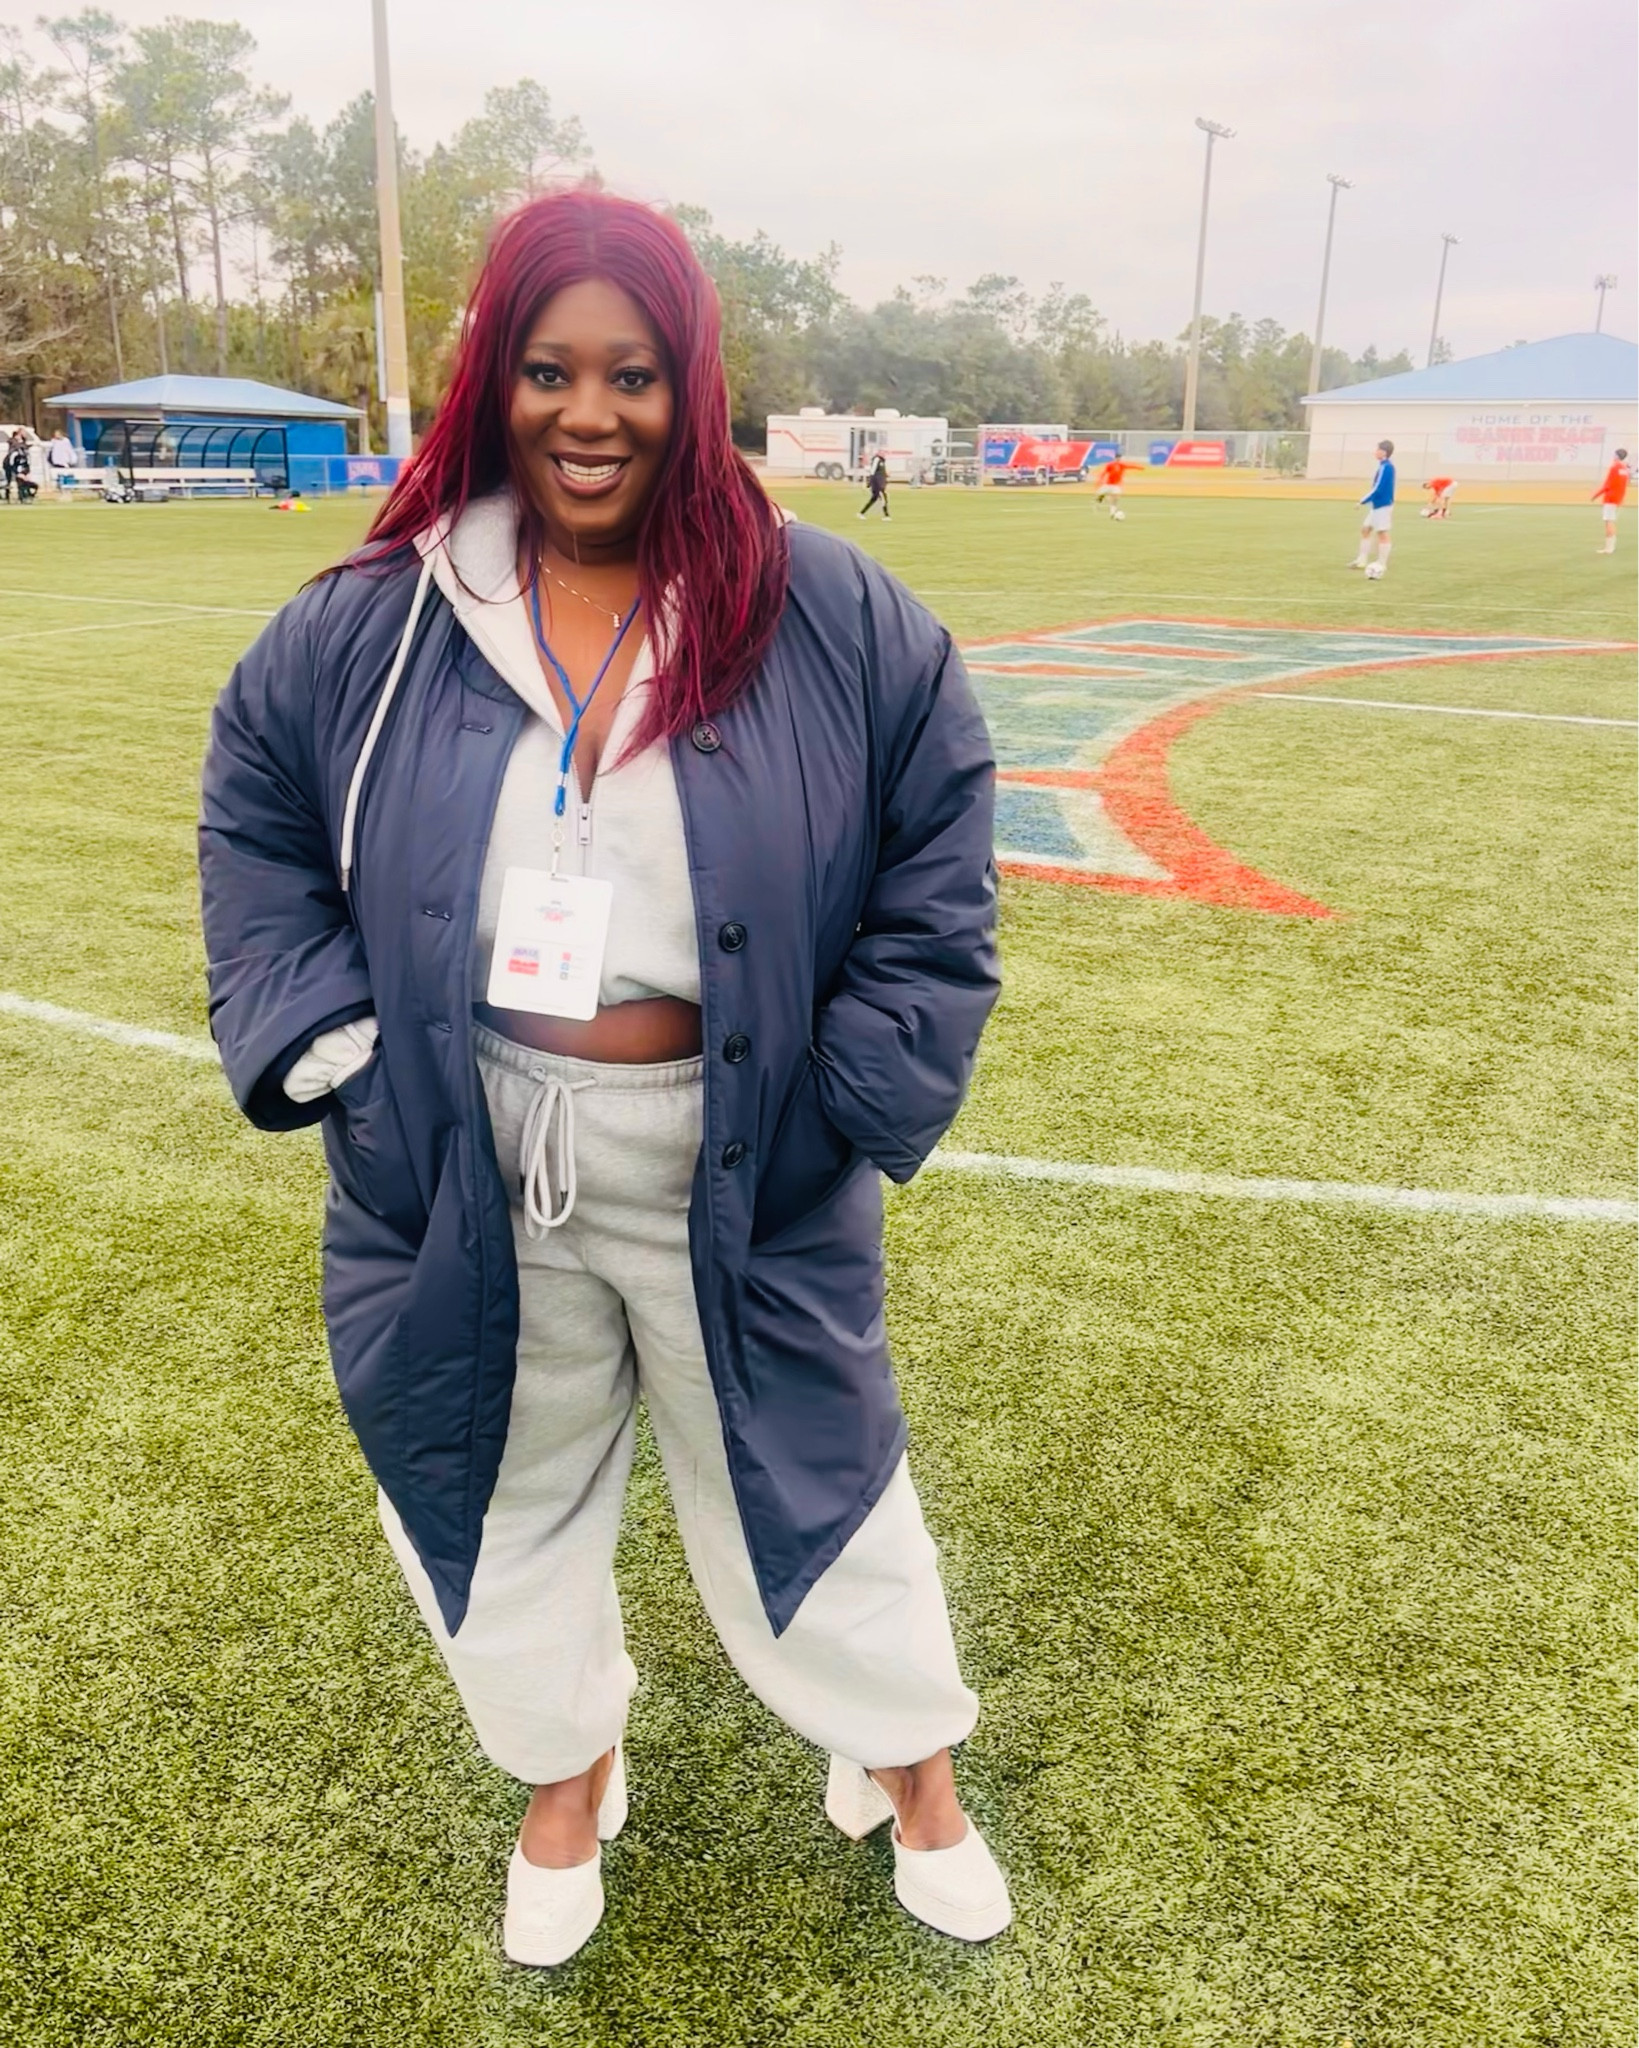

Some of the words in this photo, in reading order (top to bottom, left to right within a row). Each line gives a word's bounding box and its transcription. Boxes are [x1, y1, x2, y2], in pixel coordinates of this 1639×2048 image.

[1472, 415, 1522, 424] HOME
[1530, 415, 1552, 424] OF
[1560, 415, 1593, 424] THE
